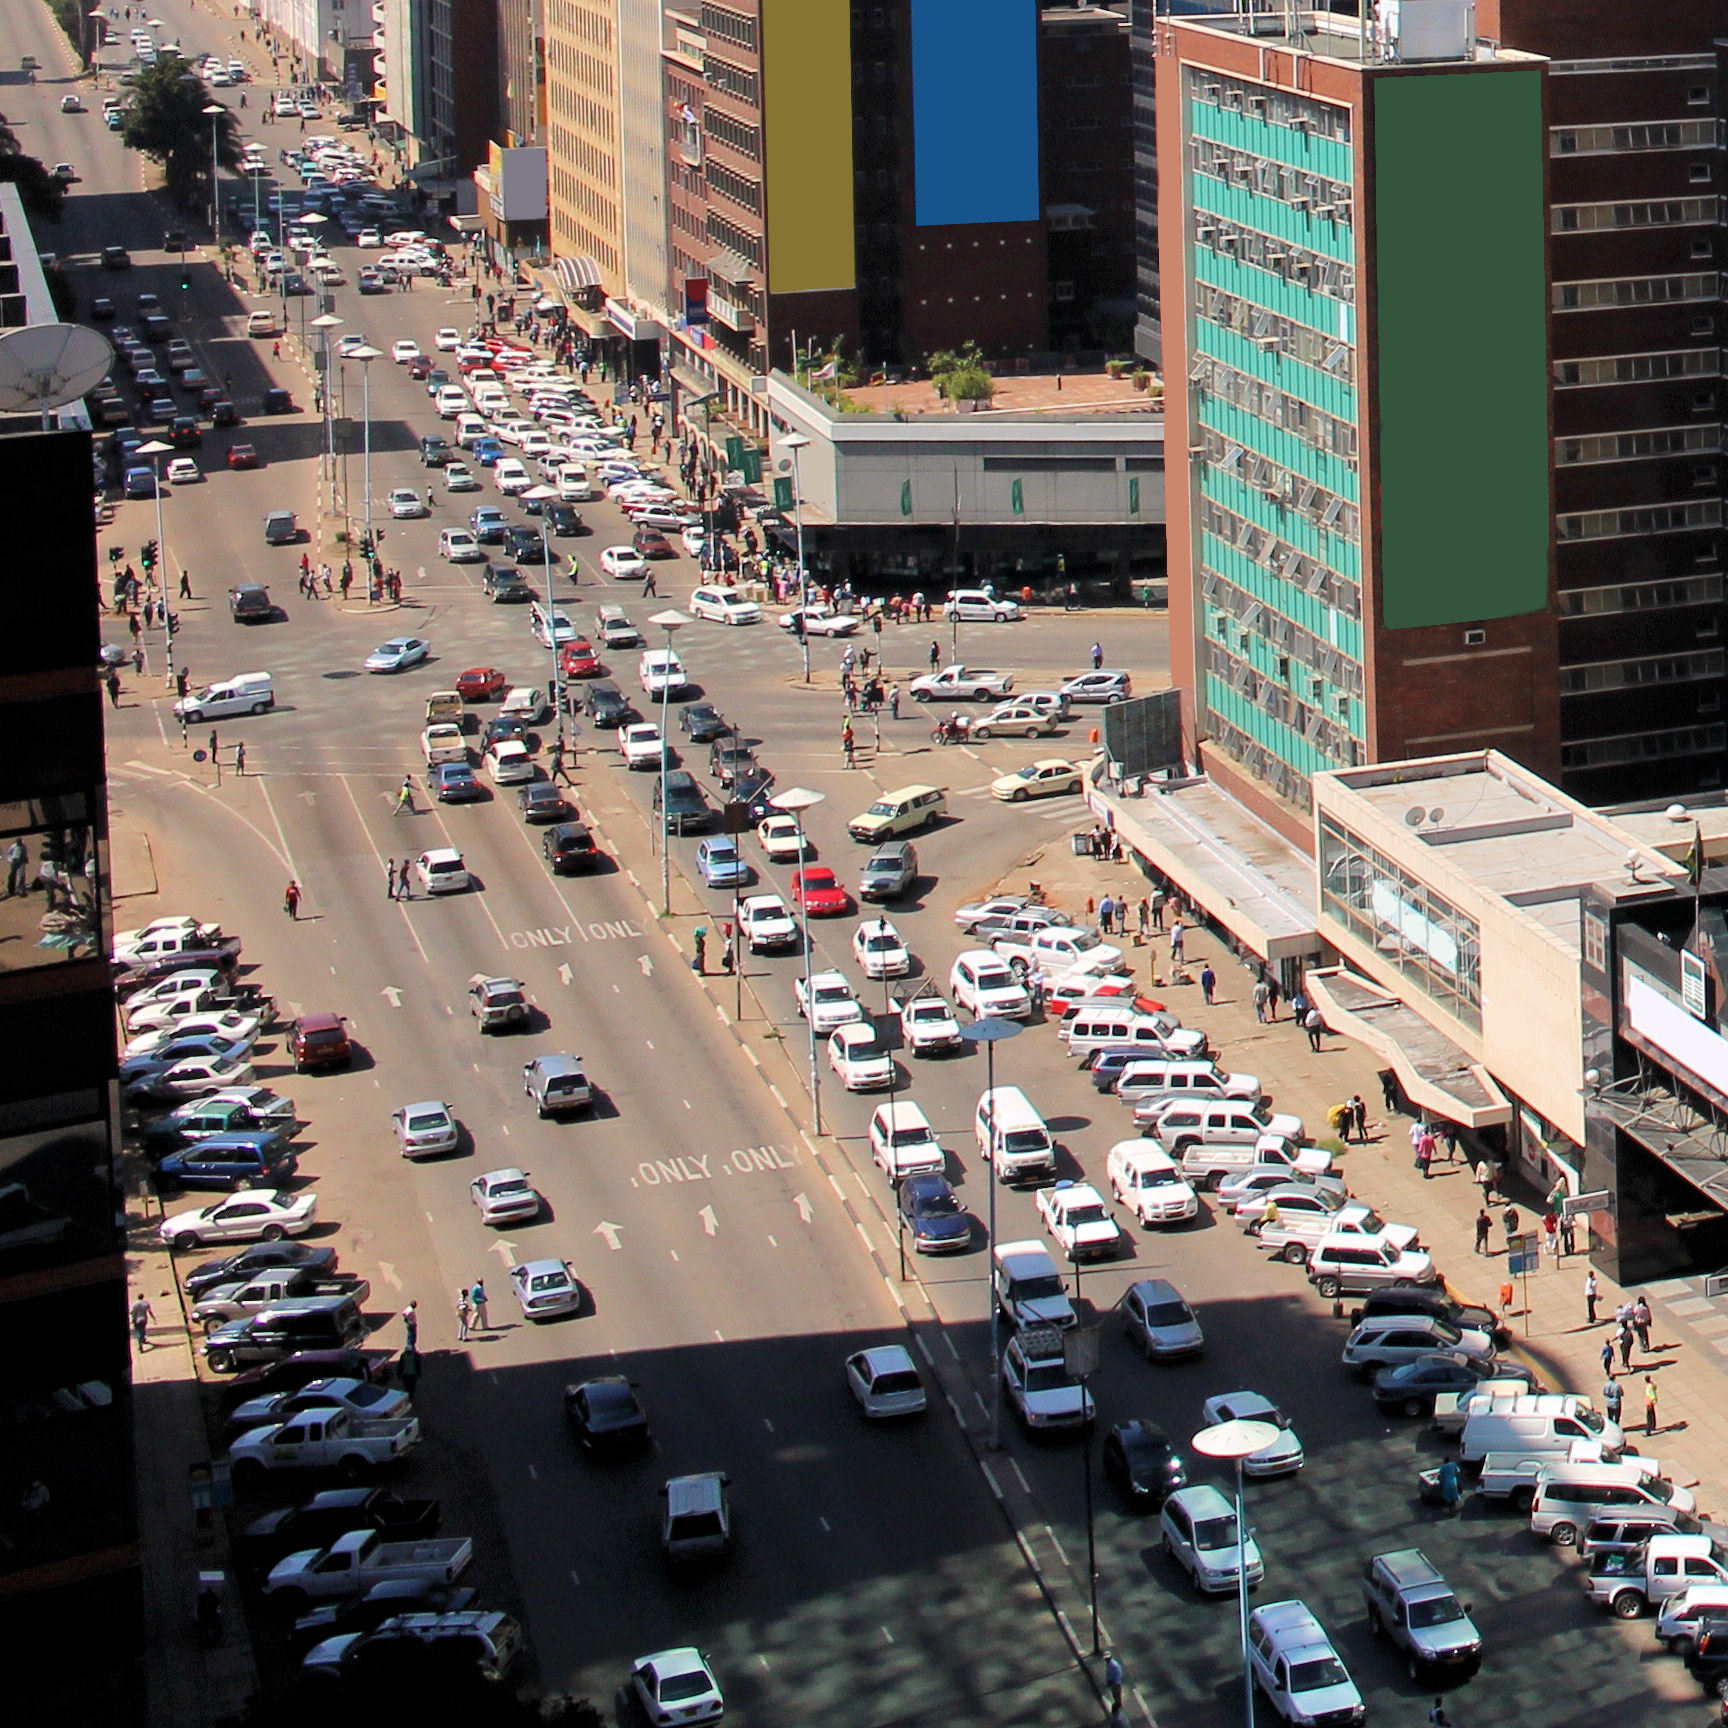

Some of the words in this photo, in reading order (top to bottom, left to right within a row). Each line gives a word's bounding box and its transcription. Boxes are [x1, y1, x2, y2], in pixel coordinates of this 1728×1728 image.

[510, 925, 573, 949] ONLY
[638, 1153, 713, 1186] ONLY
[731, 1143, 804, 1173] ONLY
